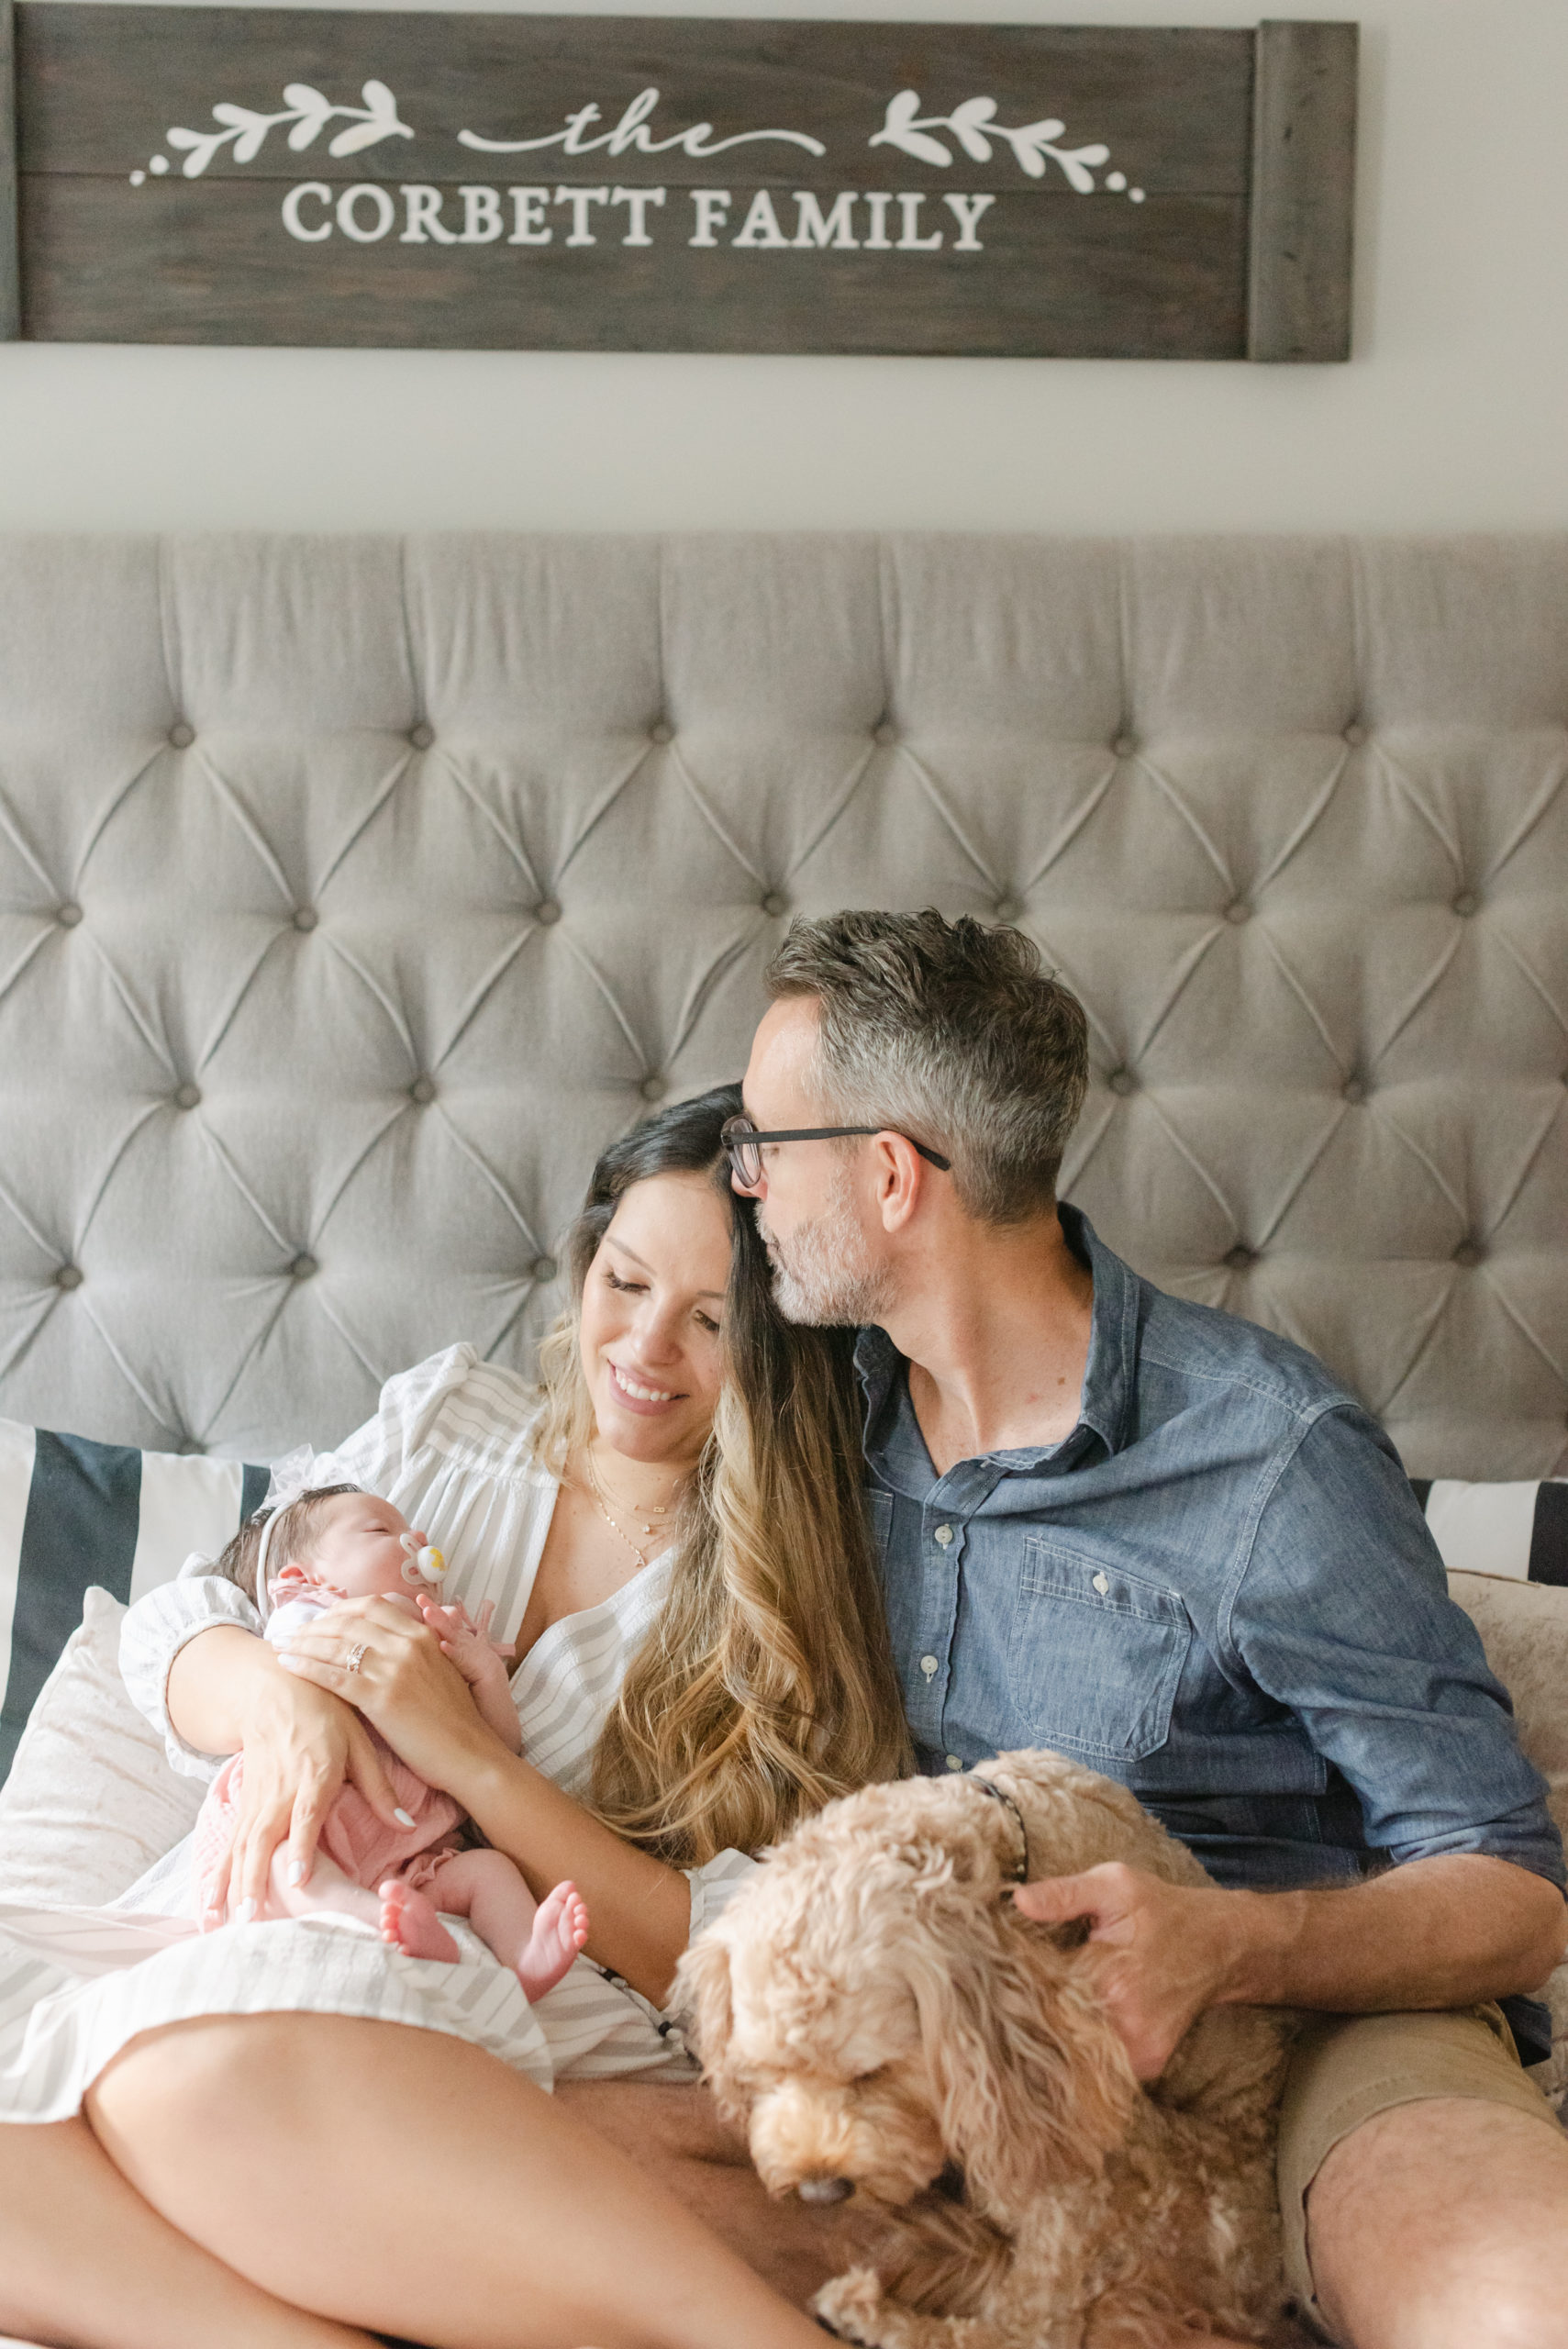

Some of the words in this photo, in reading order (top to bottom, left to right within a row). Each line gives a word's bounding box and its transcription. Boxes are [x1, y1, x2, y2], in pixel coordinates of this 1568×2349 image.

[457, 87, 826, 157] the
[281, 182, 666, 248] CORBETT
[689, 189, 995, 250] FAMILY
